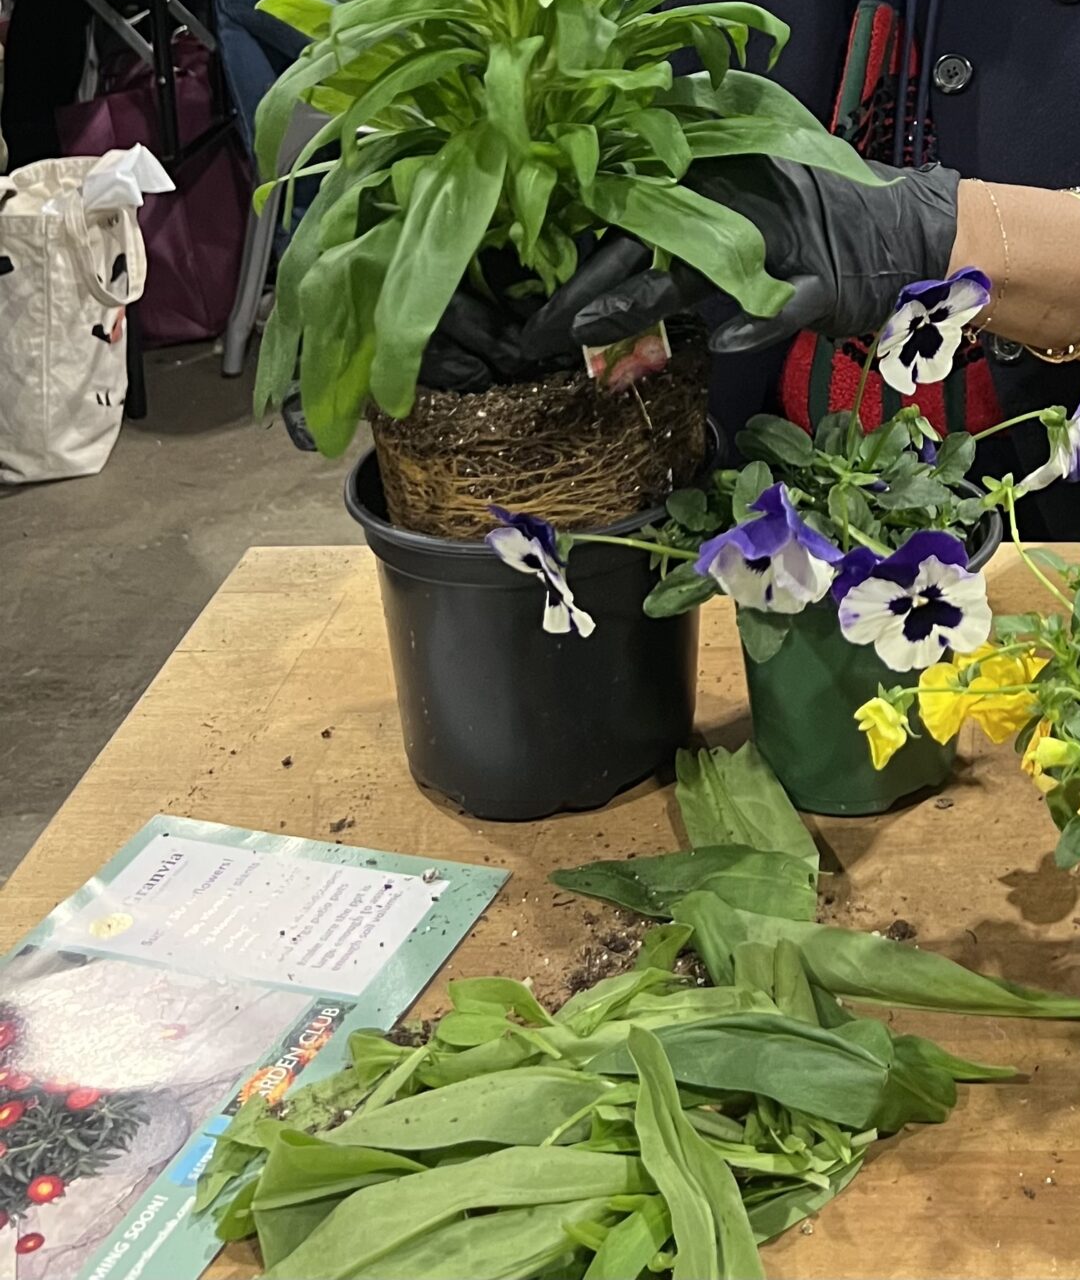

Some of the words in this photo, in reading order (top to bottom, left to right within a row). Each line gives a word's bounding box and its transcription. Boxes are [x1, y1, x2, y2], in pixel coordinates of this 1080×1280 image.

[259, 1047, 302, 1098] ARDEN
[299, 1007, 340, 1047] CLUB
[88, 1241, 130, 1280] MING
[123, 1194, 169, 1240] SOON!
